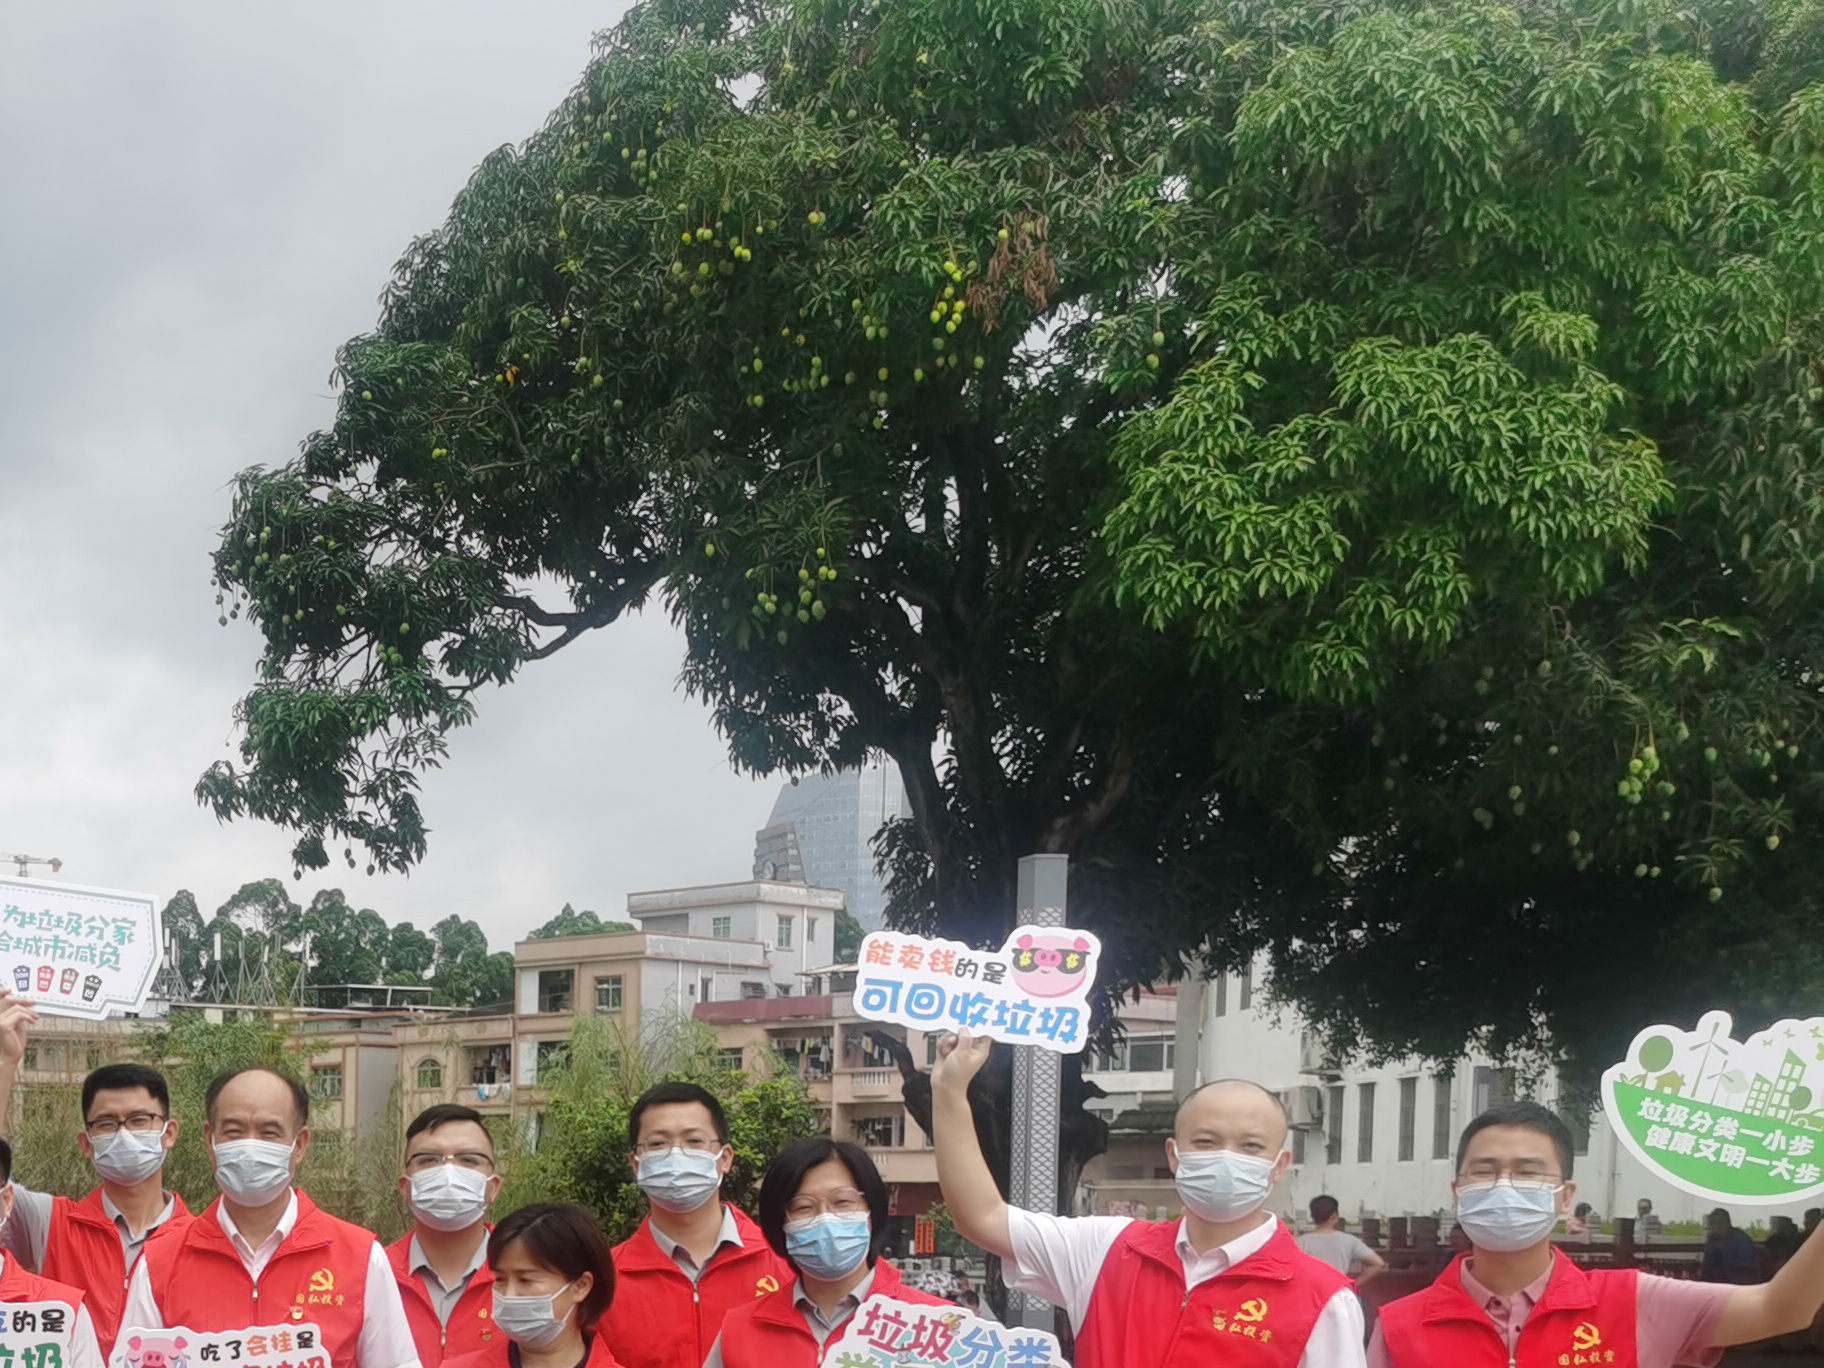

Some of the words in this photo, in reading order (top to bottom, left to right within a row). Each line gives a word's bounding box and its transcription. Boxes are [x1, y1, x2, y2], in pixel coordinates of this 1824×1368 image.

[3, 904, 137, 945] 为垃圾分家
[865, 939, 1007, 984] 能卖钱的是
[862, 978, 1080, 1044] 可回收垃圾
[1637, 1097, 1815, 1156] 垃圾分类一小步
[1645, 1125, 1821, 1184] 健康文明一大步
